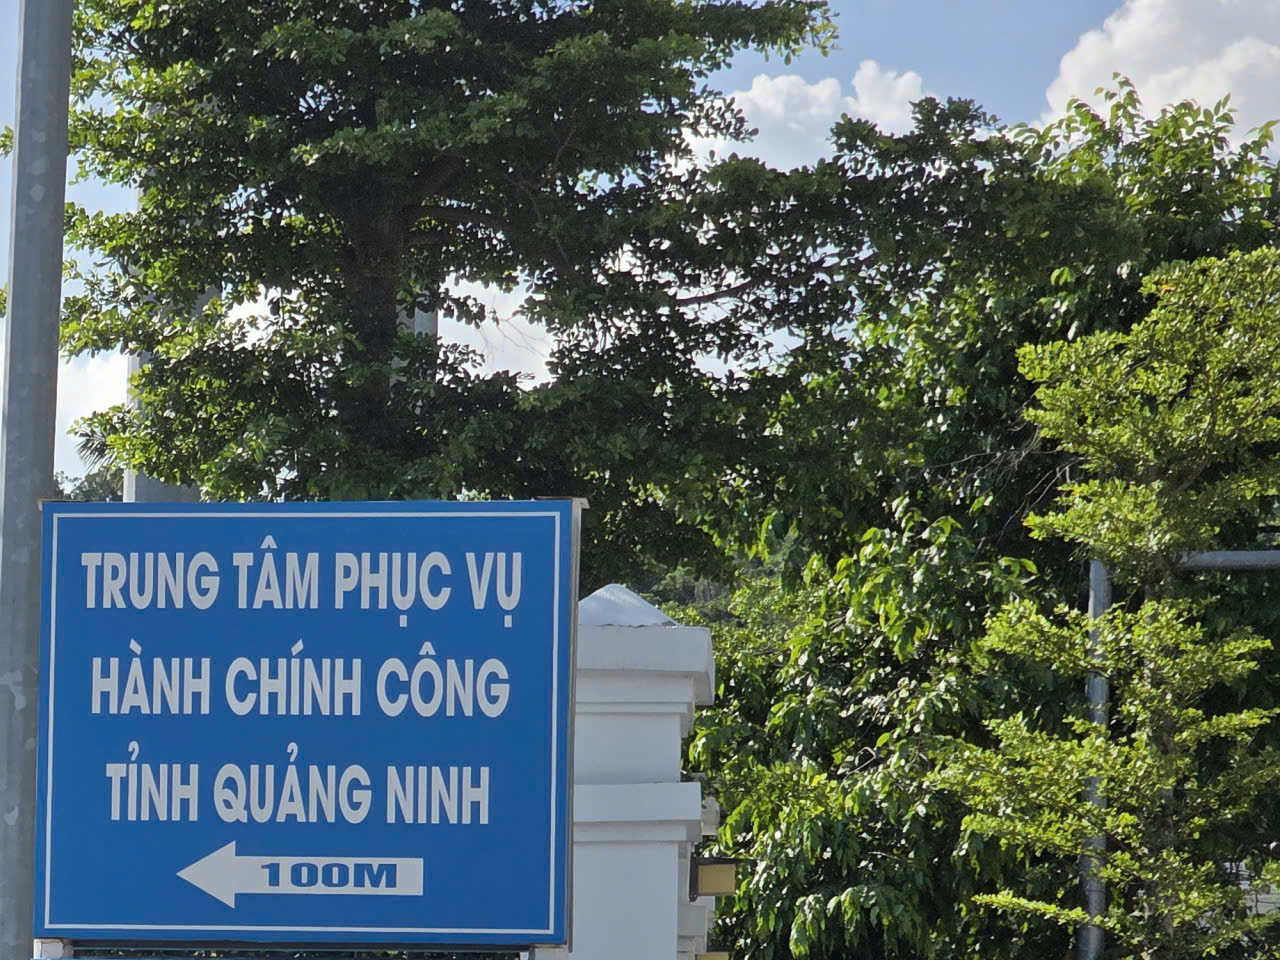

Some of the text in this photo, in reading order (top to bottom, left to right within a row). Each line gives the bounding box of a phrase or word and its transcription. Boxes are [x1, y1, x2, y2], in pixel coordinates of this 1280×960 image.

[82, 536, 521, 627] TRUNG TÂM PHỤC VỤ
[92, 640, 509, 717] HÀNH CHÍNH CÔNG
[106, 741, 489, 824] TỈNH QUẢNG NINH
[261, 863, 397, 888] 100M
